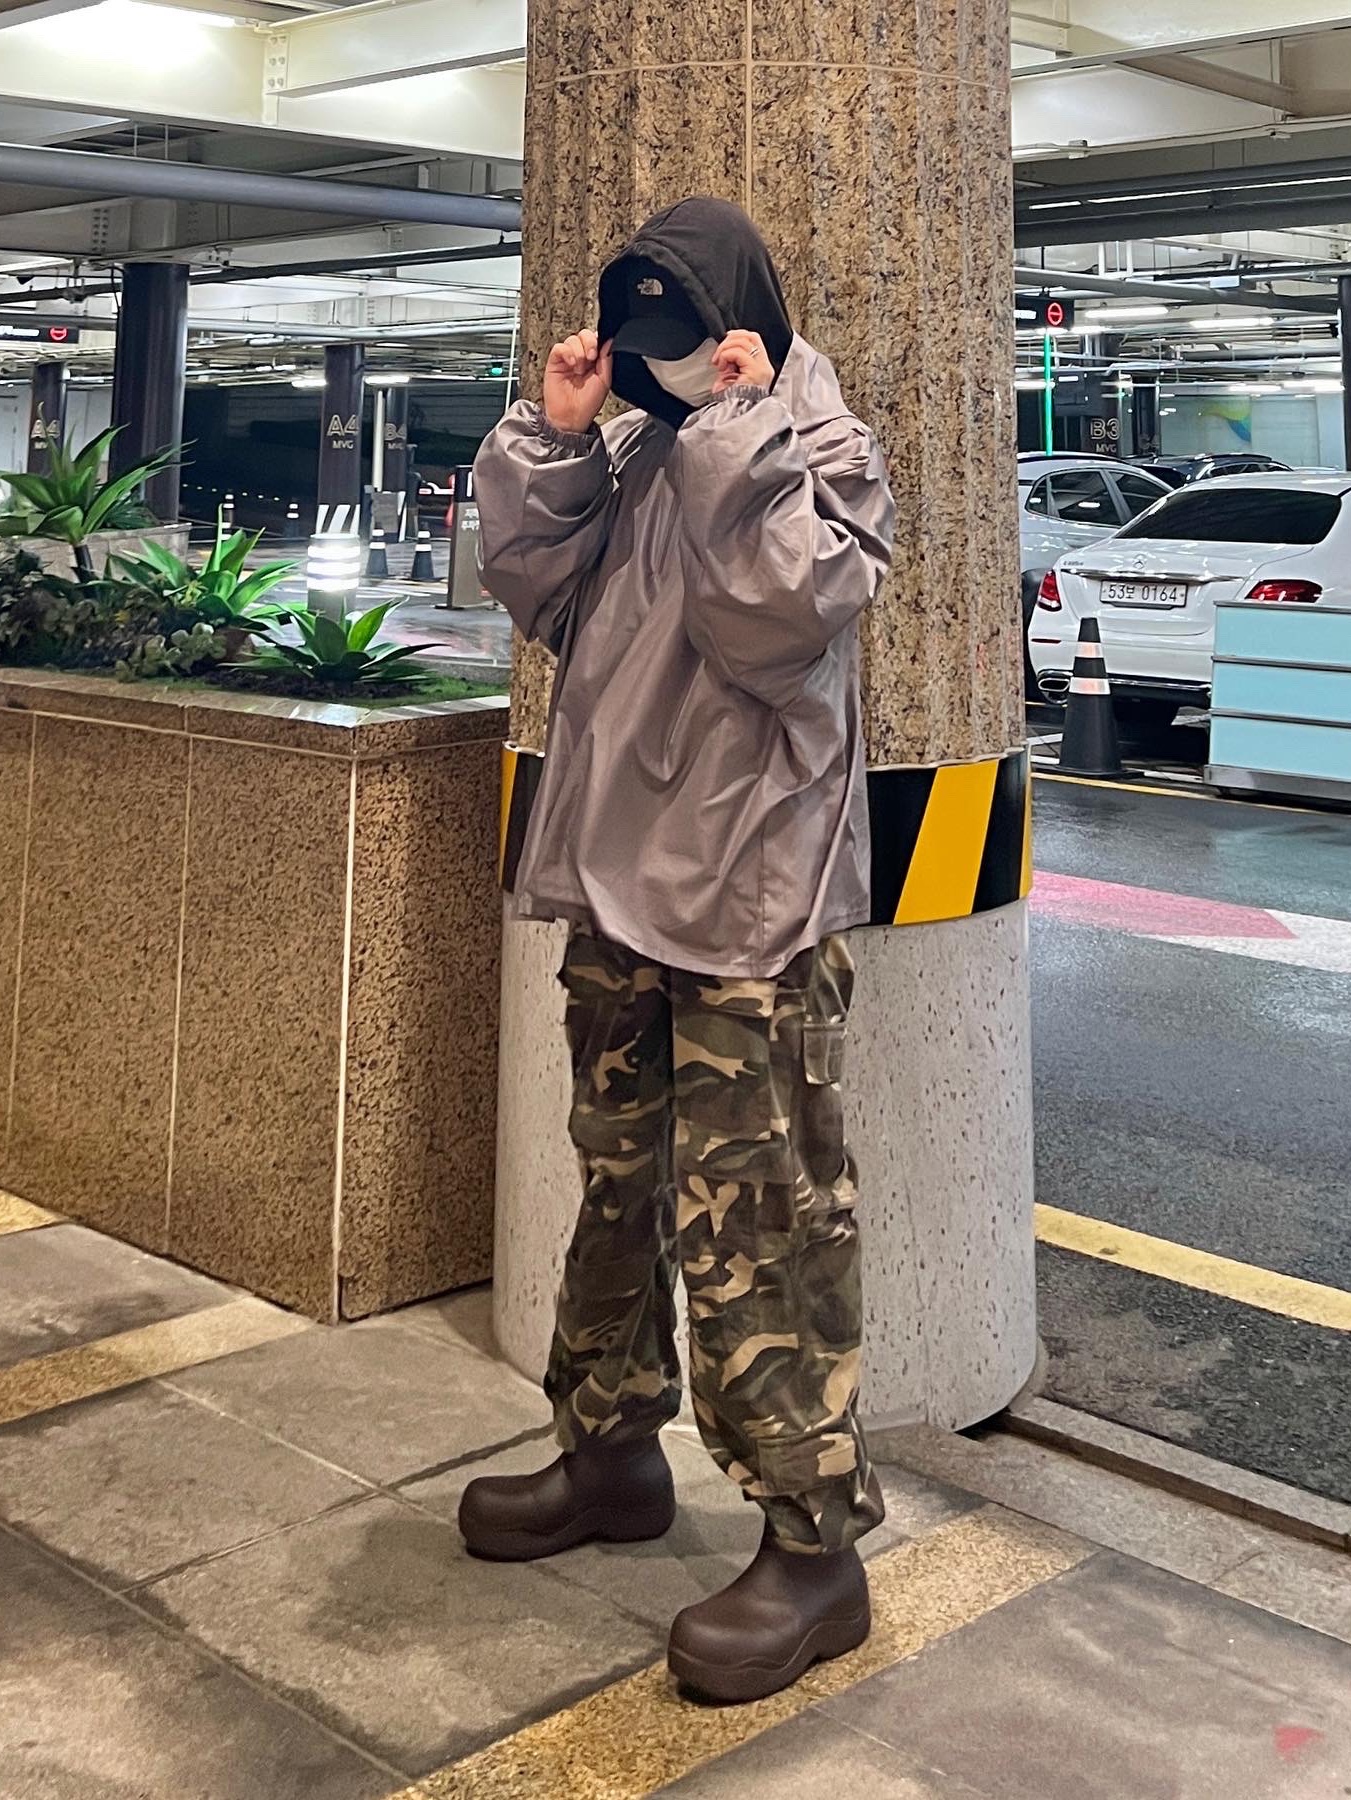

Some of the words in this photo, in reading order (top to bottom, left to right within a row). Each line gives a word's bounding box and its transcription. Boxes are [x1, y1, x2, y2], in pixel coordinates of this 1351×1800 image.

[31, 419, 60, 438] A4
[327, 415, 359, 436] A4
[383, 423, 407, 441] B4
[1090, 418, 1119, 440] B3
[332, 441, 354, 449] MVG
[1096, 443, 1117, 453] MVG
[1108, 584, 1135, 599] 53보
[1142, 586, 1177, 602] 0164
